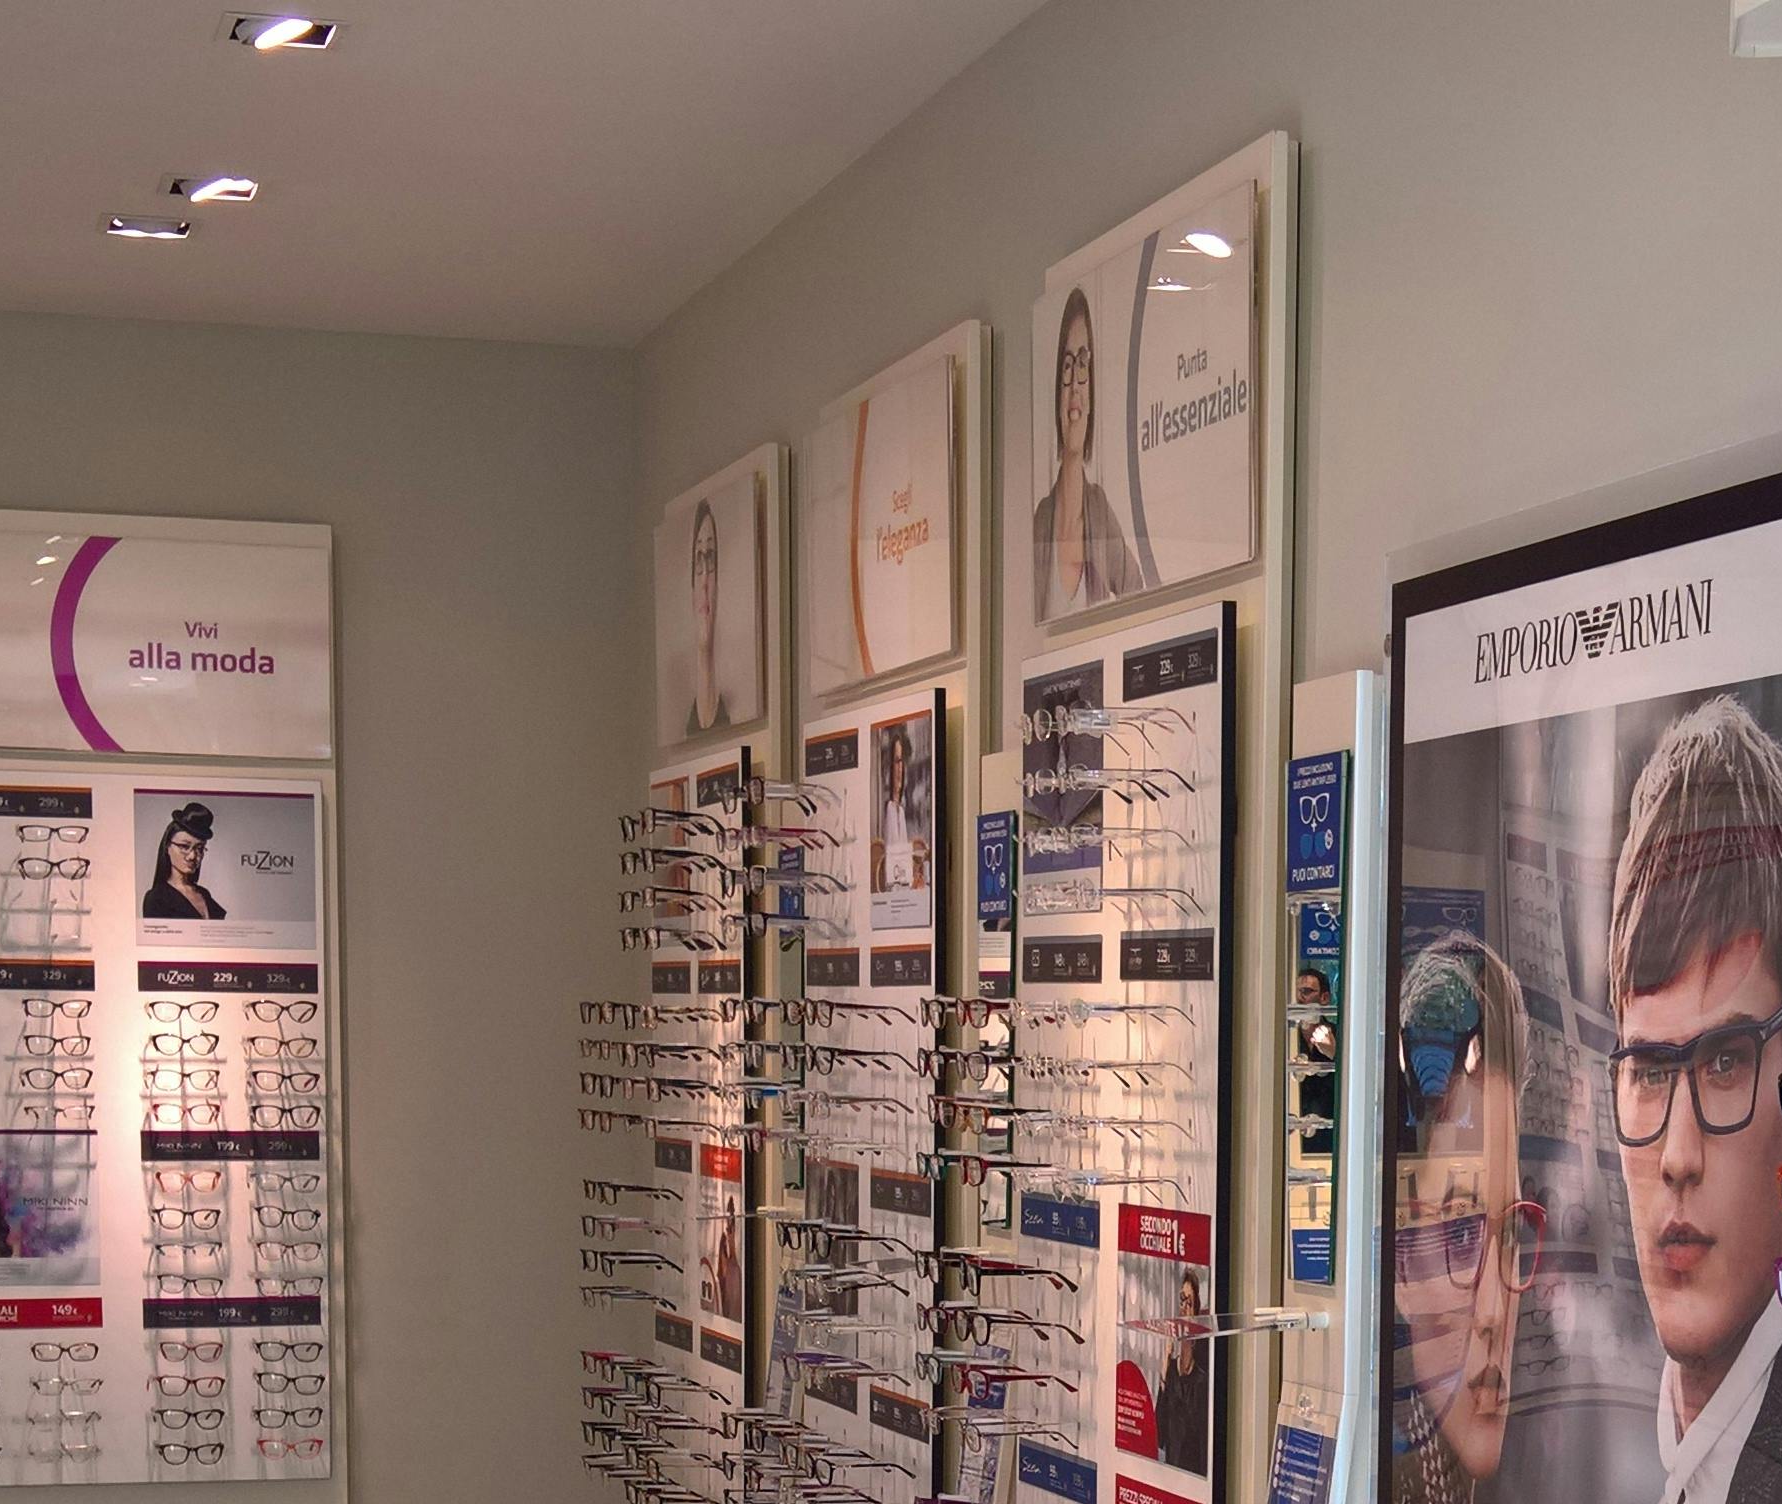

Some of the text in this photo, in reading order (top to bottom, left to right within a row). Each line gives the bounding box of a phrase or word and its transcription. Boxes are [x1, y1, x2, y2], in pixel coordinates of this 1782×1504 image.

[1177, 347, 1208, 381] Punta
[1142, 369, 1247, 451] all'essenziale
[876, 516, 929, 564] l'eleganza
[184, 621, 218, 640] Vivi
[1474, 578, 1714, 684] EMPORIO ARMANI
[129, 643, 275, 674] alla moda
[241, 851, 294, 870] FUZION
[1292, 864, 1335, 882] PUOI CONTARCI
[157, 970, 194, 984] FUZION
[1140, 1215, 1171, 1235] SECONDO
[1140, 1233, 1171, 1253] OCCHIALE
